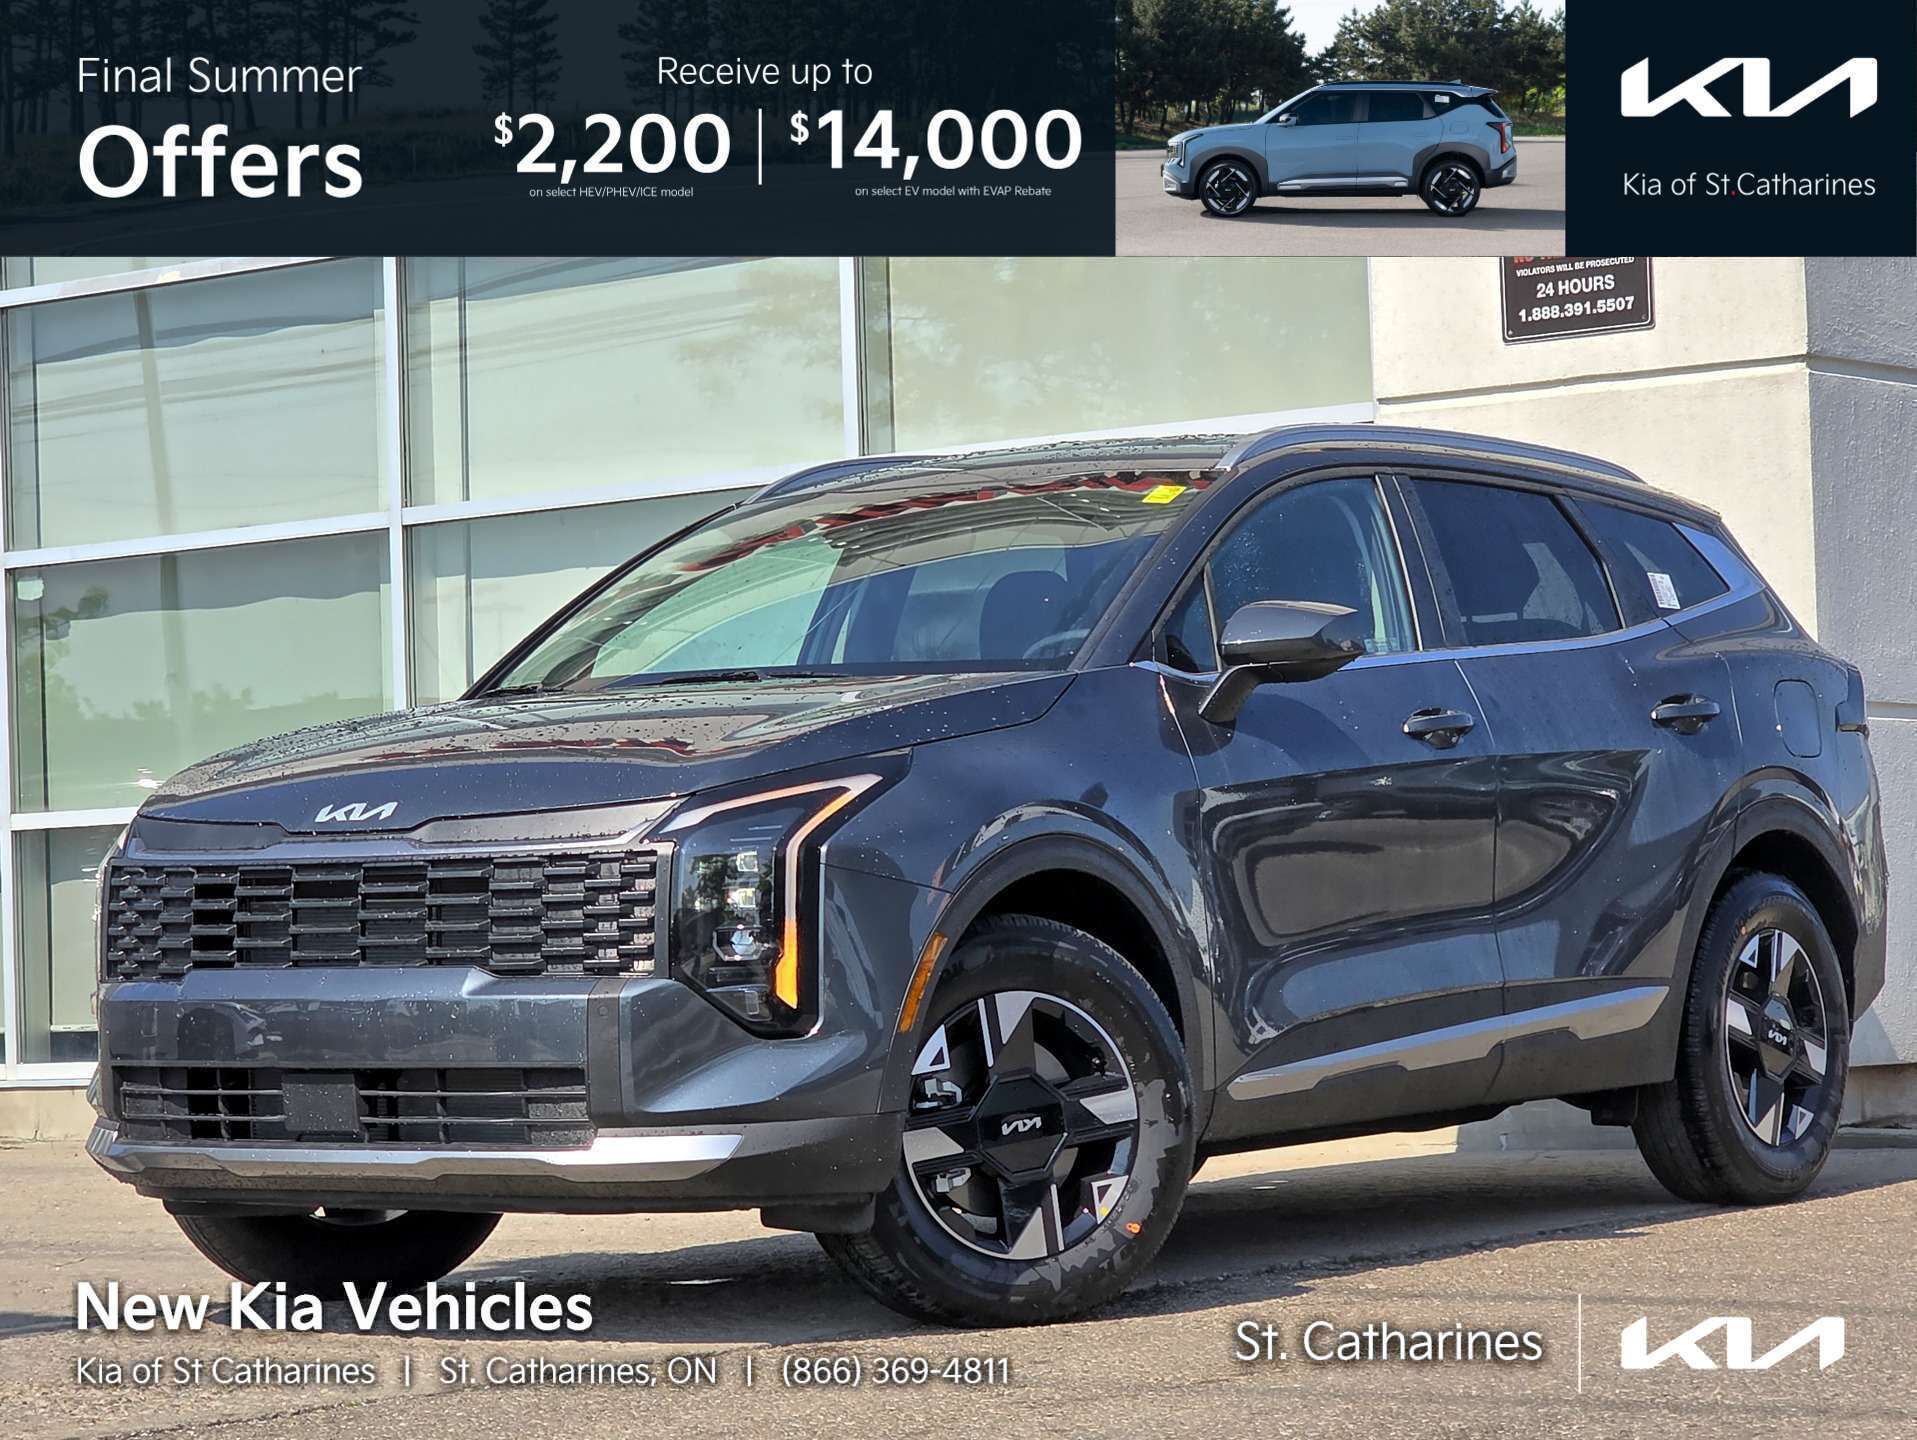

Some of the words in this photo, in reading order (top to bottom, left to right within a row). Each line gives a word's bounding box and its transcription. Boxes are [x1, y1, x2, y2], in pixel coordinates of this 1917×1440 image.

[1516, 264, 1556, 277] VIOLATORS
[1556, 263, 1573, 272] WILL
[1575, 261, 1585, 270] BE
[1586, 256, 1634, 269] PROSECUTED
[1536, 281, 1555, 298] 24
[1558, 274, 1615, 296] HOURS
[1518, 296, 1634, 322] 1.888.391.5507
[315, 802, 398, 822] KIA
